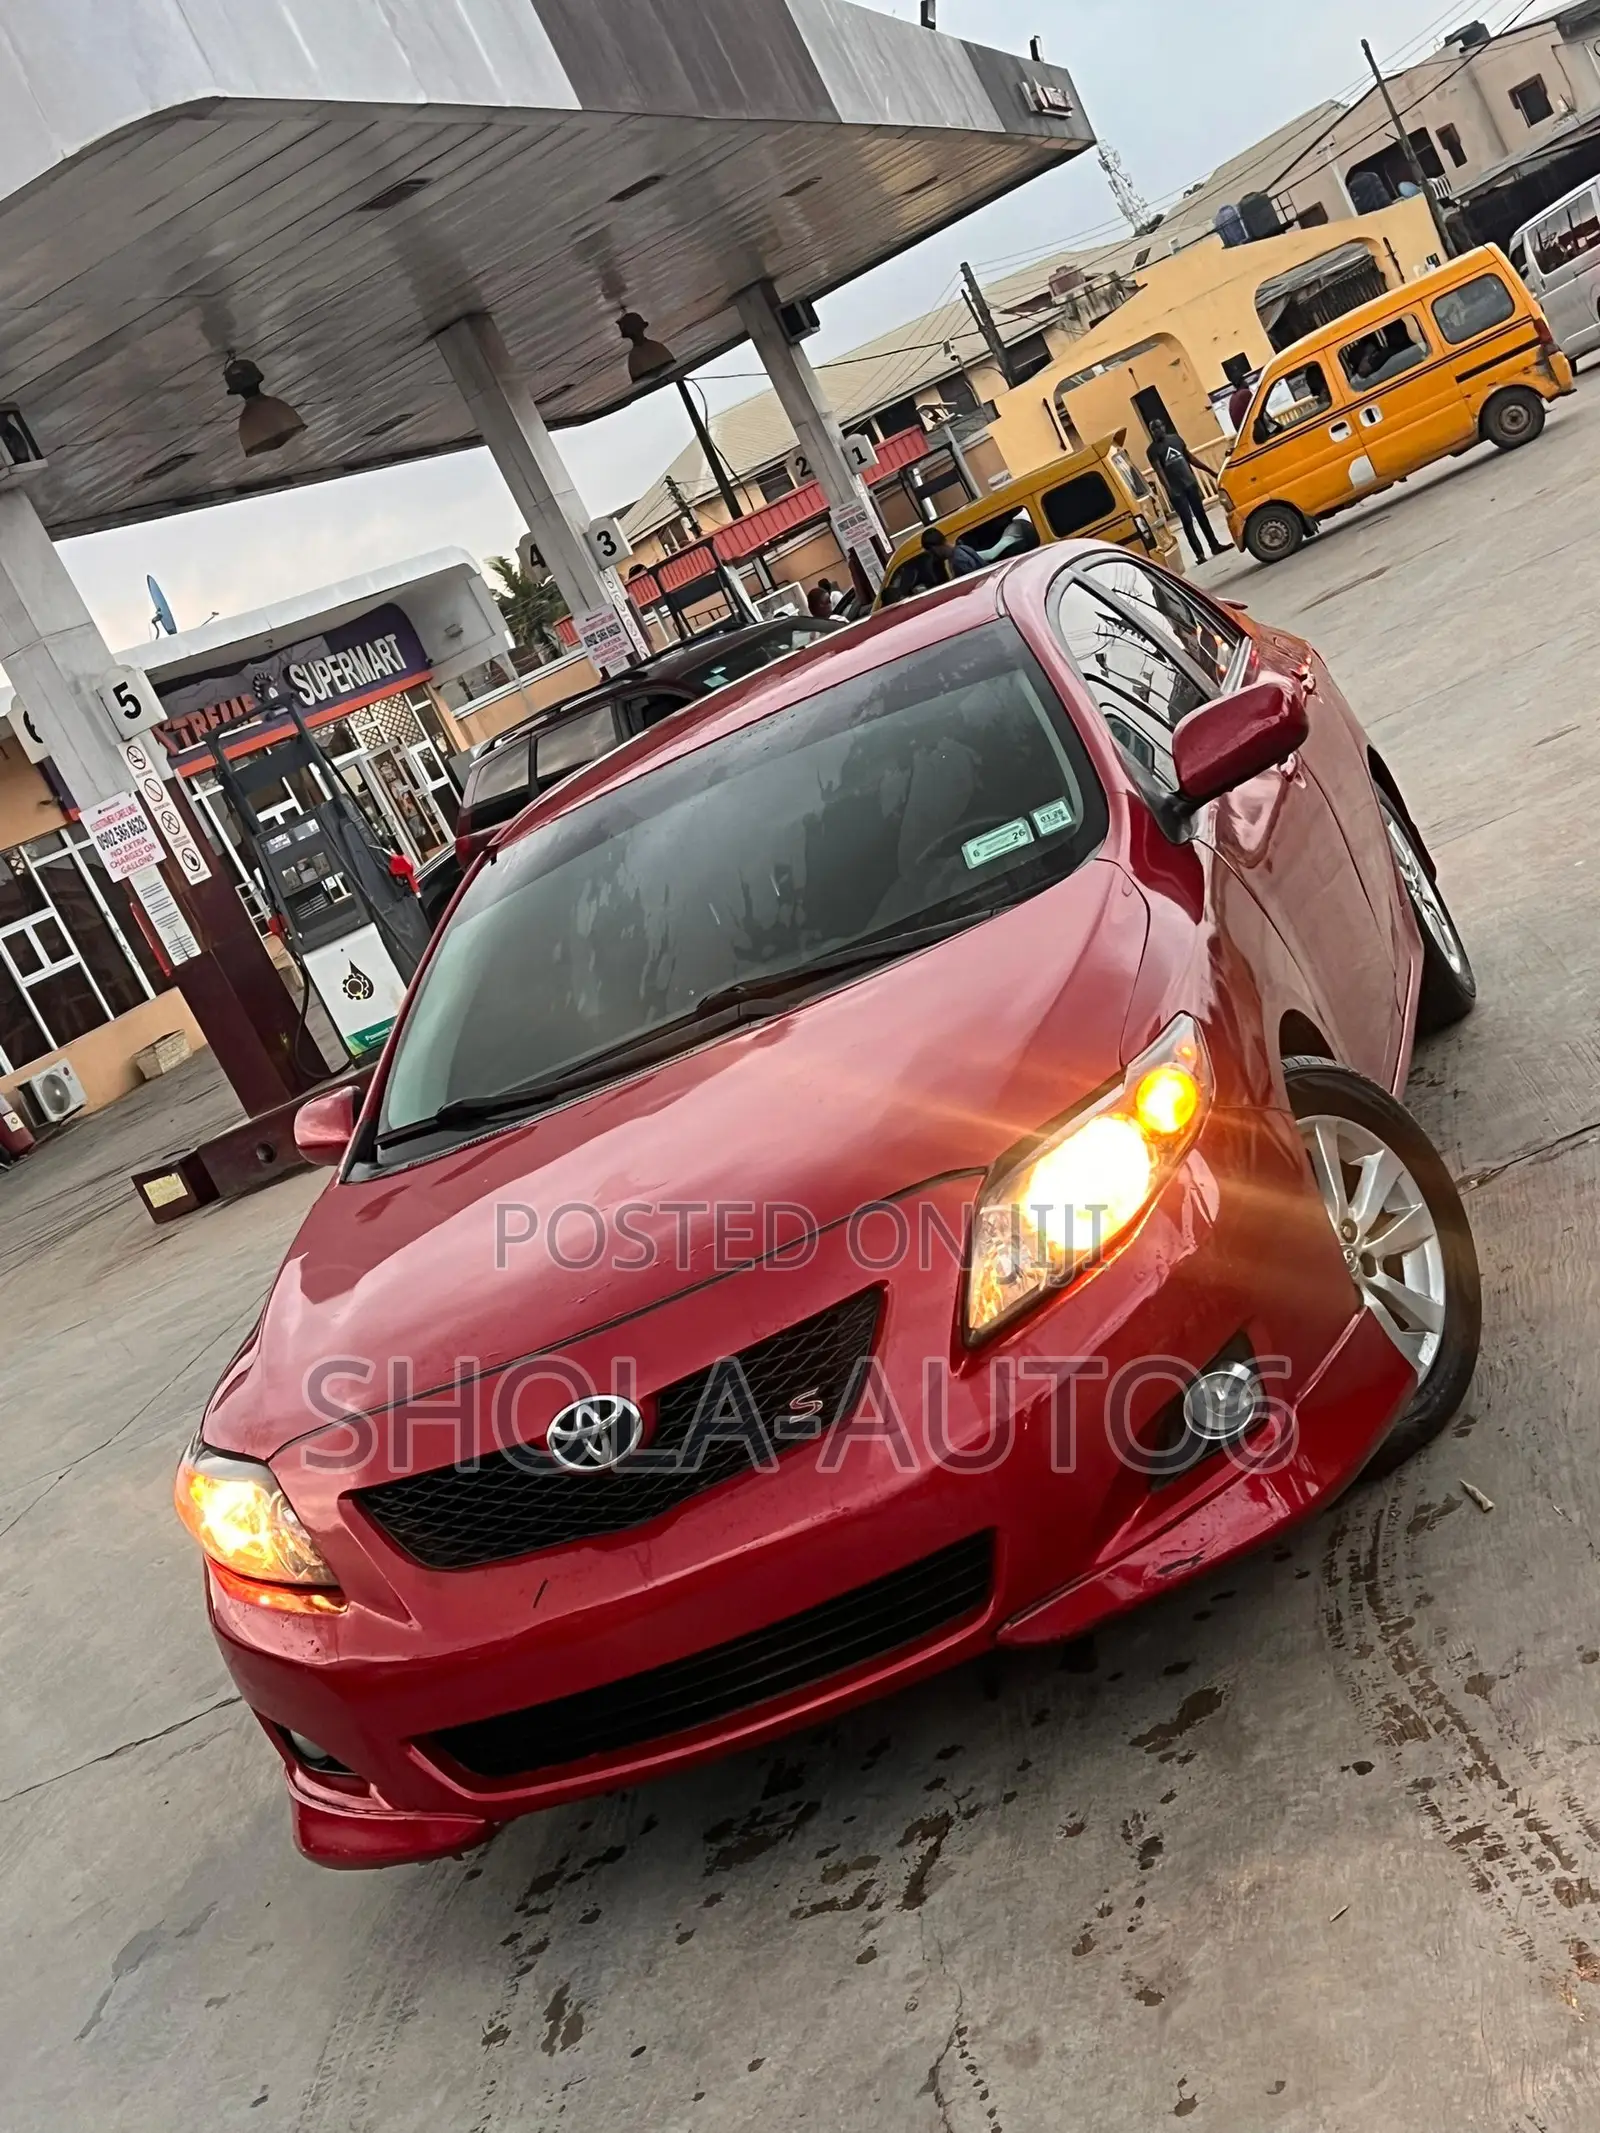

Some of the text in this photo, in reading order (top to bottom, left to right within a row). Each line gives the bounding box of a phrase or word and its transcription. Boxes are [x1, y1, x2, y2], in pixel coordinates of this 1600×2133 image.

[795, 457, 812, 477] 2
[852, 447, 867, 465] 1
[530, 543, 546, 568] 4
[597, 530, 617, 557] 3
[285, 633, 407, 706] SUPERMART
[112, 681, 142, 719] 5
[110, 837, 147, 858] NO EXTRA
[110, 842, 156, 869] CHARGES ON
[120, 854, 154, 874] GALLONS
[789, 1387, 823, 1424] S
